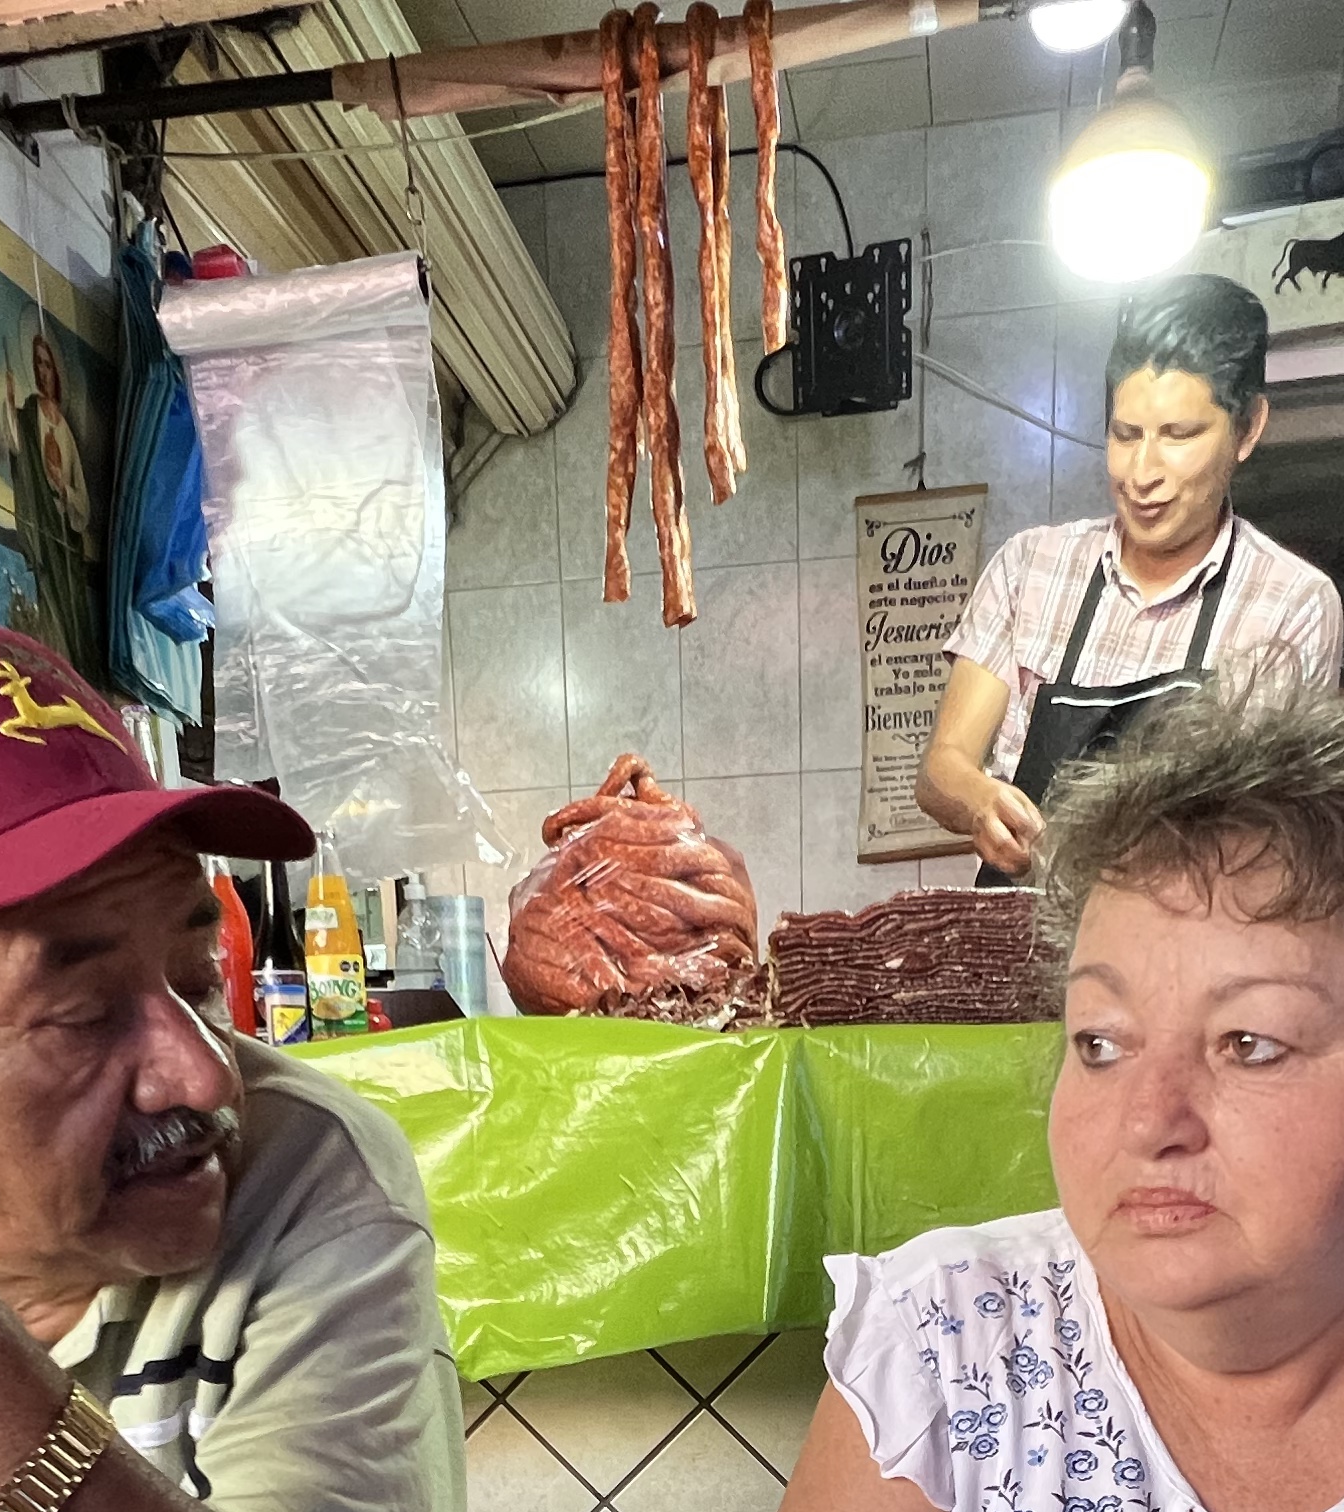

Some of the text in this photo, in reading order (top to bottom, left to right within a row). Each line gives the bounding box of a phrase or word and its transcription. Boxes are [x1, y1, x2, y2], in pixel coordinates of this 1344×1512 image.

[880, 527, 957, 573] Dios
[868, 573, 968, 593] es el dueño de
[900, 591, 955, 608] negocio
[958, 592, 968, 605] y
[864, 611, 962, 652] Jesucrist
[870, 652, 943, 669] el encarga
[892, 668, 910, 680] Yo
[874, 682, 925, 698] trabajo
